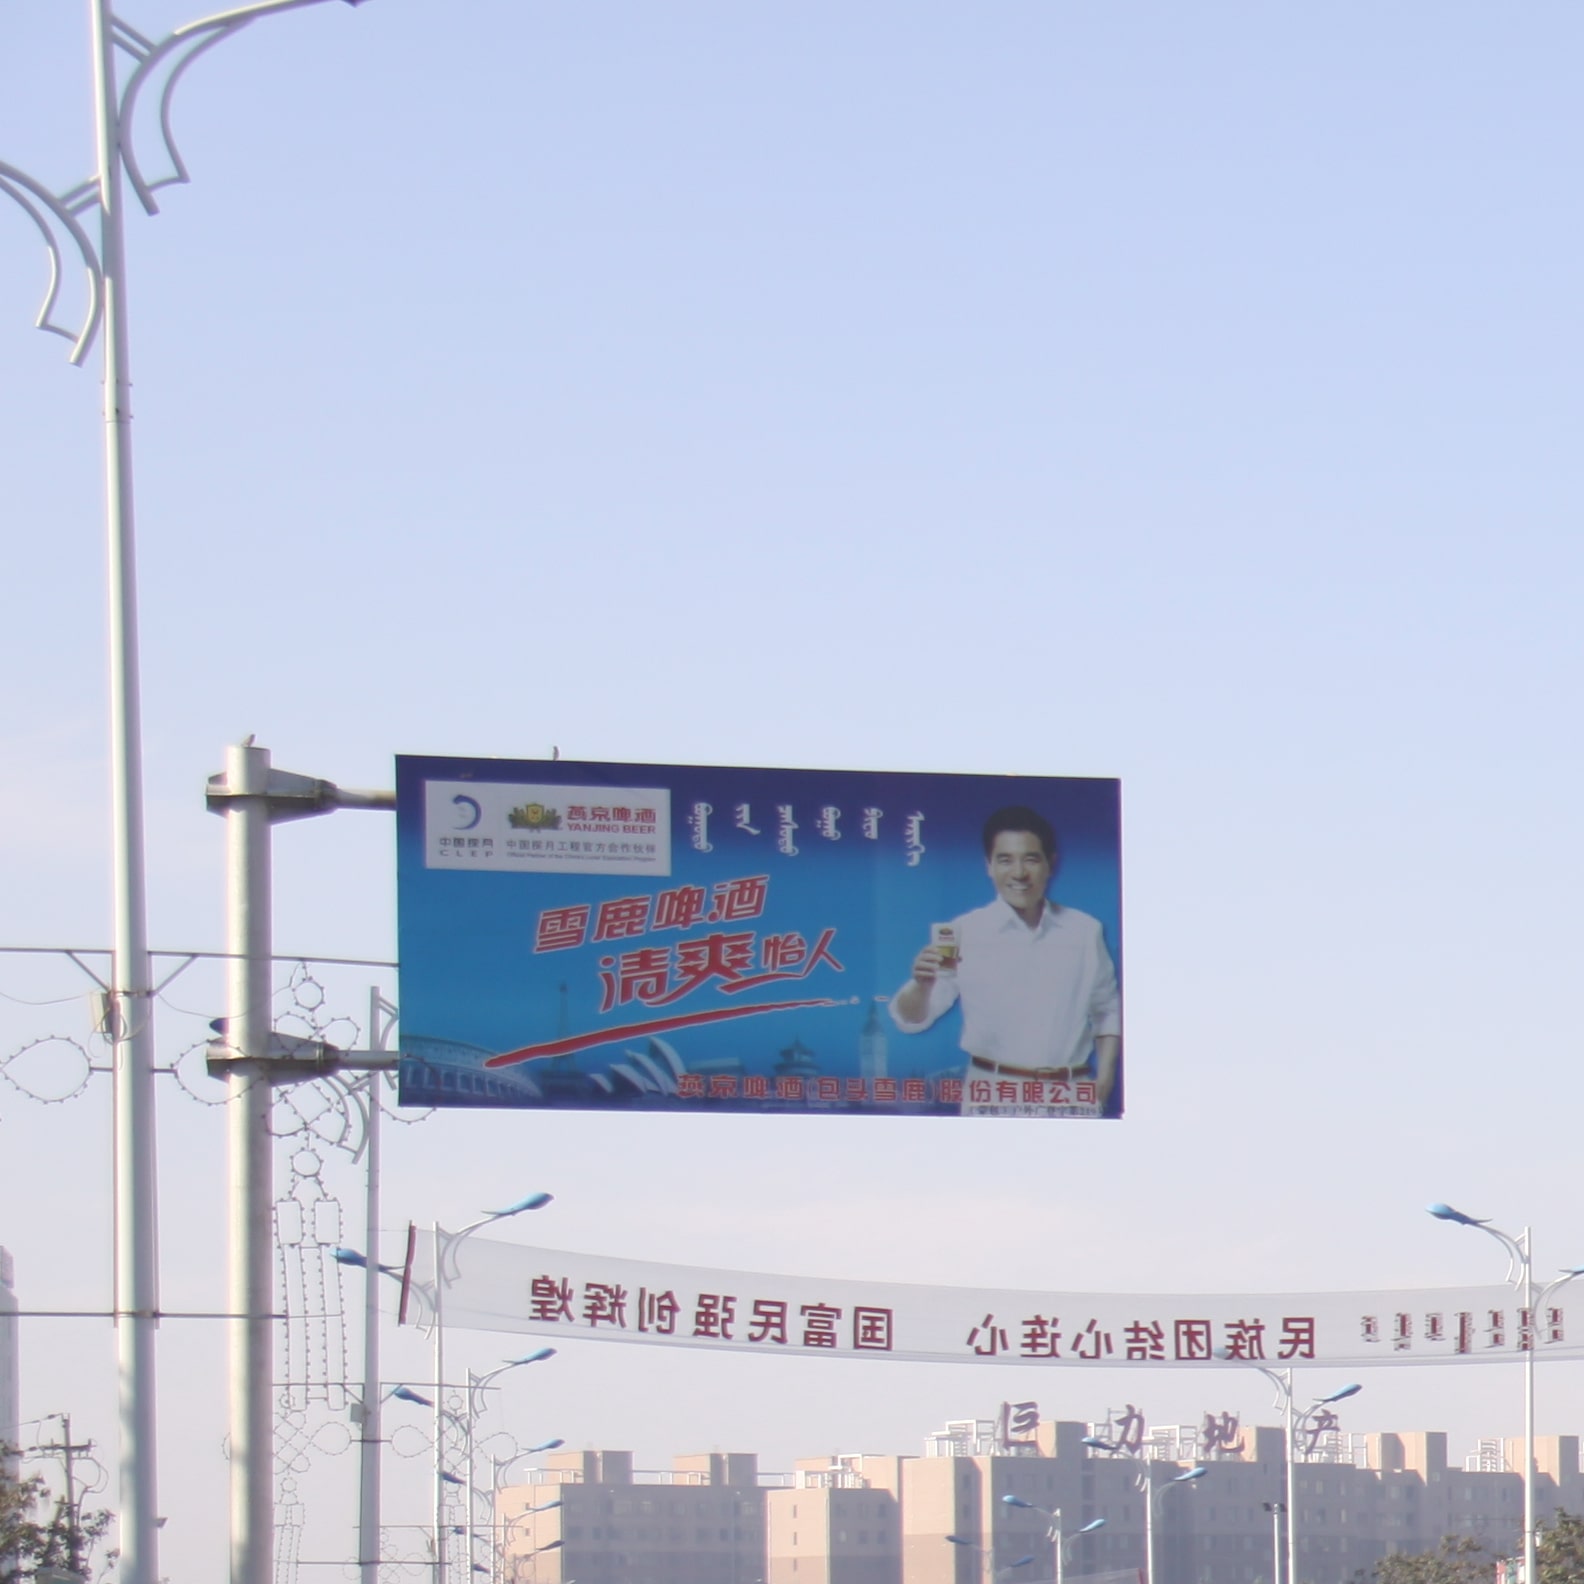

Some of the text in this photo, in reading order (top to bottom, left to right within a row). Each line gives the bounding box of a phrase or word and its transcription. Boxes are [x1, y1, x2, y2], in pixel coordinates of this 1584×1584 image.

[566, 806, 657, 824] 燕京啤酒
[567, 823, 657, 835] YANJING BEER
[439, 837, 494, 849] 中国探月
[506, 839, 657, 854] 中国探月工程官方合作伙伴
[534, 874, 769, 953] 雪鹿啤酒
[600, 929, 844, 1013] 清爽怡人
[1002, 1401, 1341, 1454] 巨力地产
